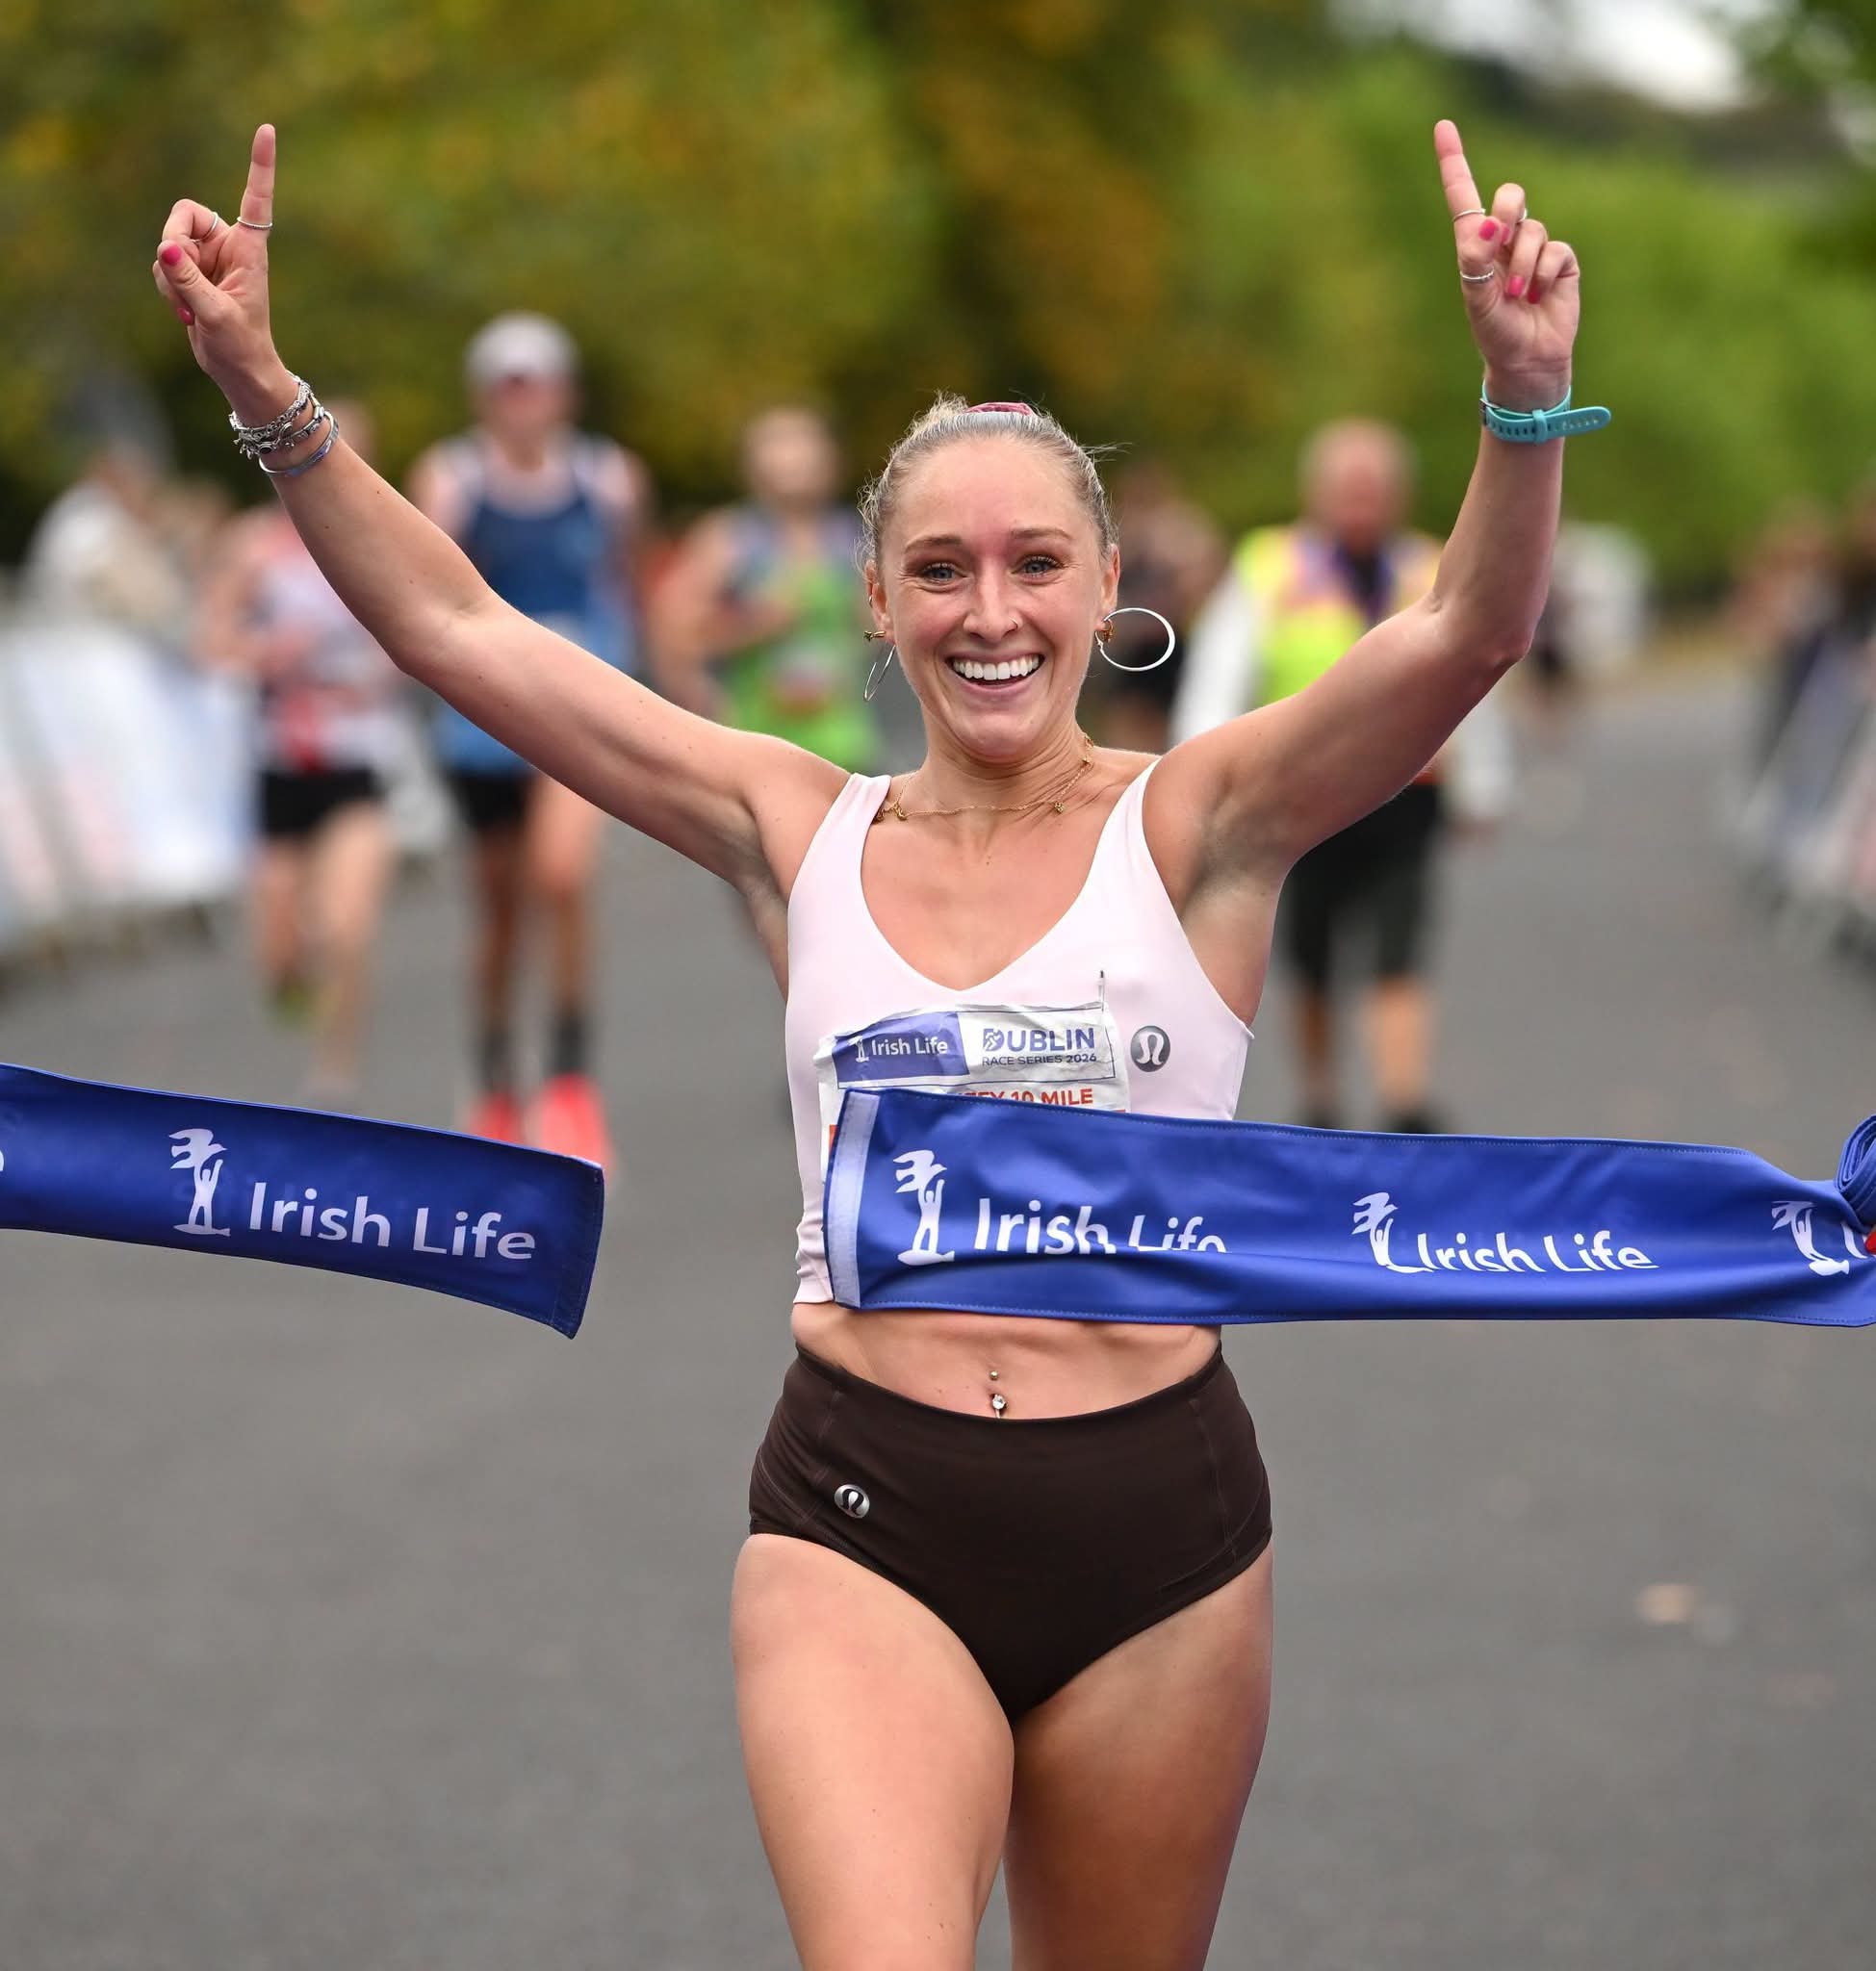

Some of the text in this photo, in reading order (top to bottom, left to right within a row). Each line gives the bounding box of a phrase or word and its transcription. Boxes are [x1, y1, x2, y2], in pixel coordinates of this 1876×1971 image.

[871, 1036, 948, 1056] Irish Life
[983, 1027, 1095, 1053] DUBLIN
[982, 1053, 1097, 1066] RACE SERIES 2026
[1041, 1088, 1093, 1106] MILE
[249, 1182, 536, 1260] Irish Life
[973, 1197, 1118, 1254] Irish
[1417, 1230, 1660, 1272] Irish Life
